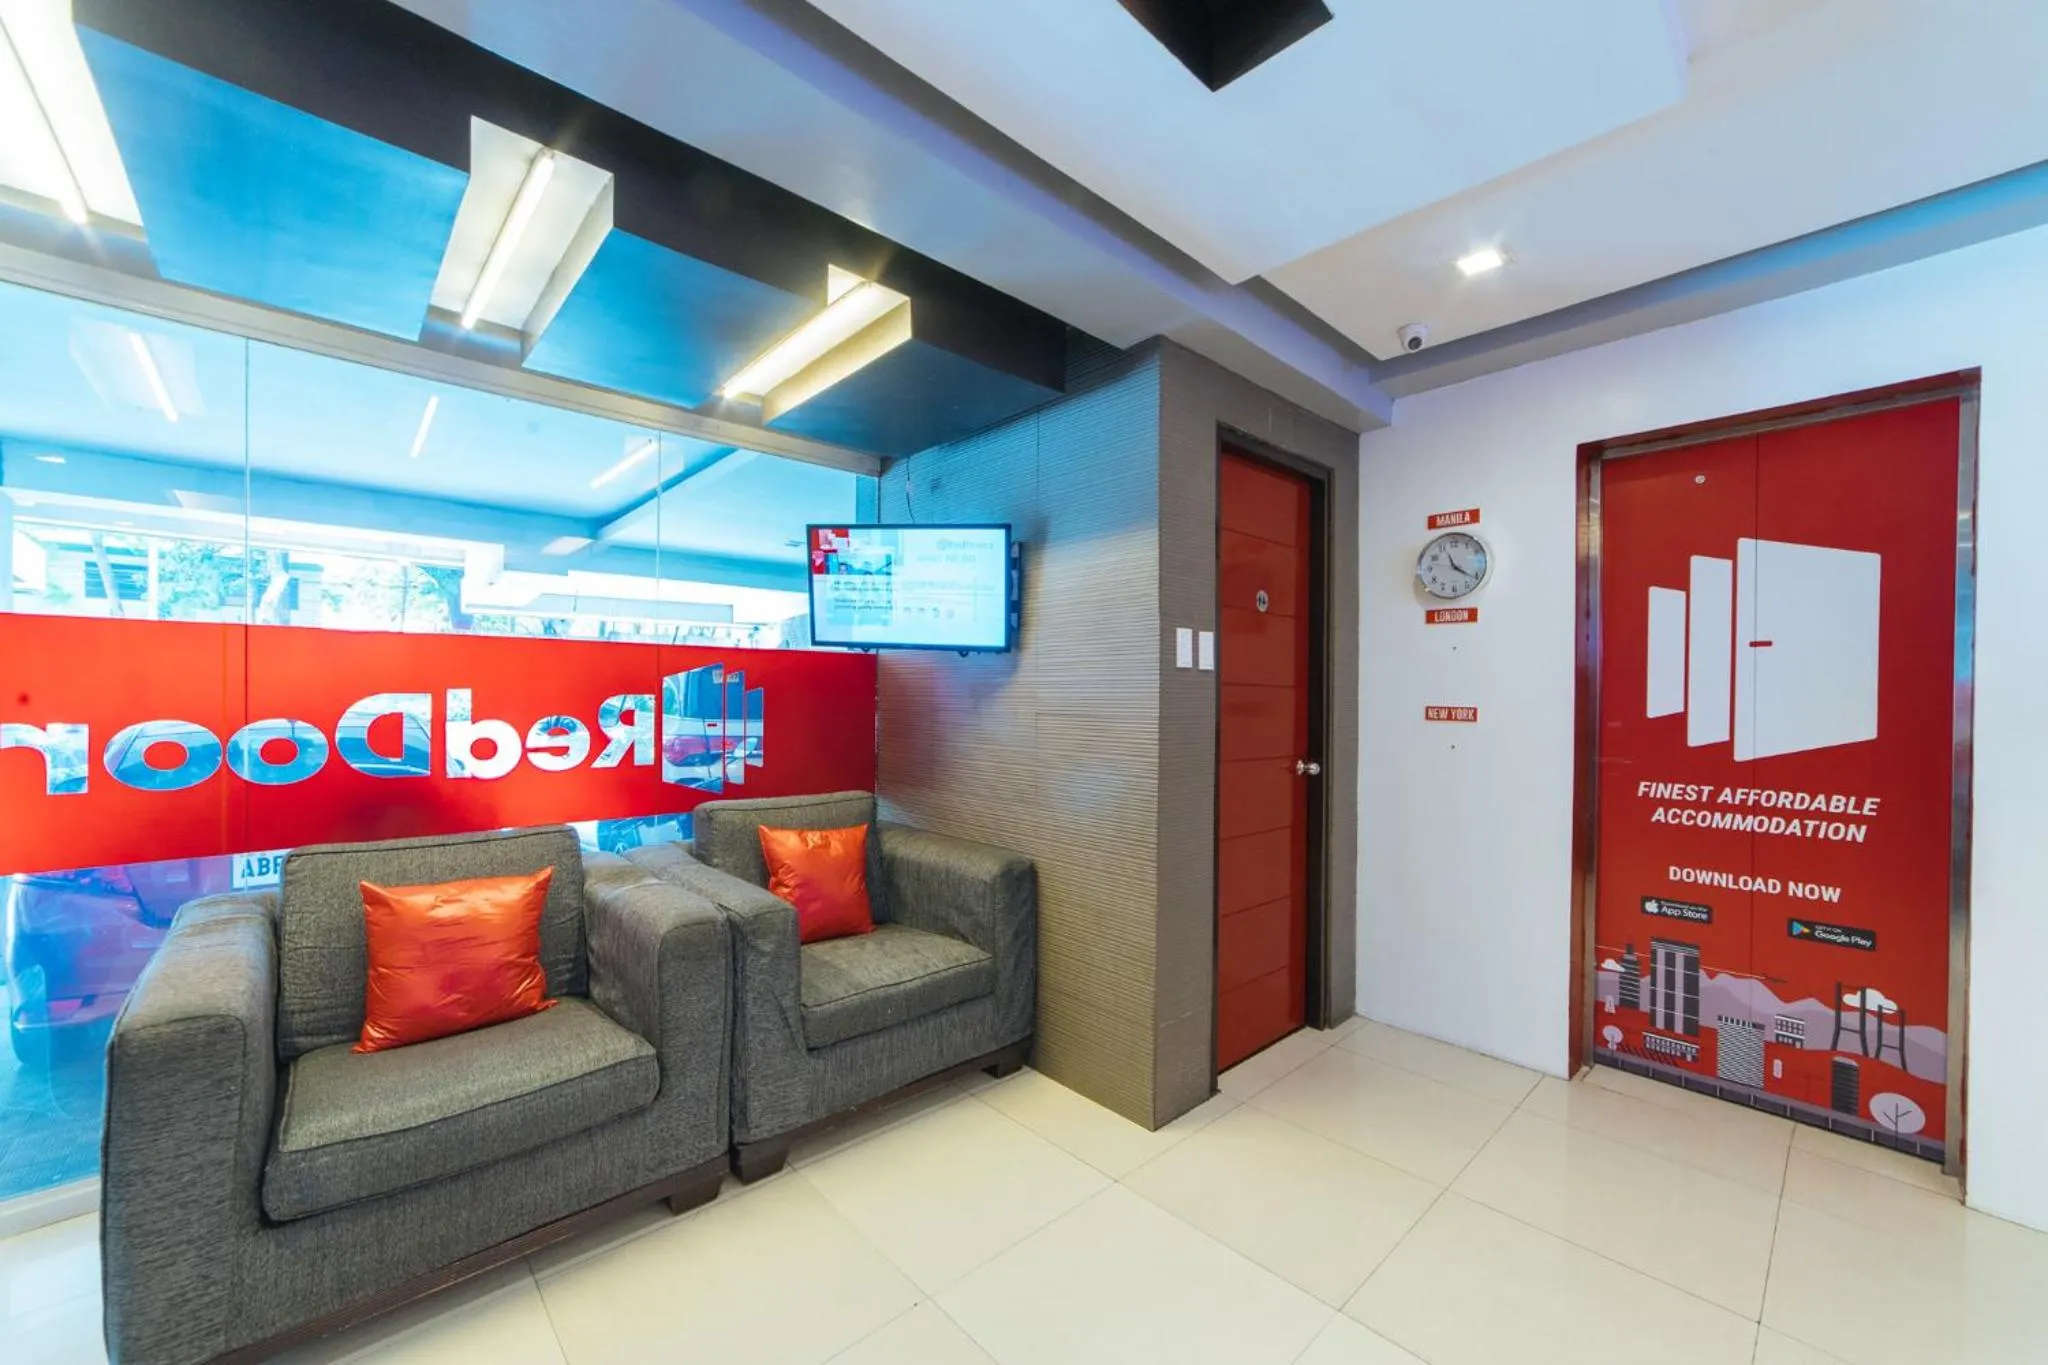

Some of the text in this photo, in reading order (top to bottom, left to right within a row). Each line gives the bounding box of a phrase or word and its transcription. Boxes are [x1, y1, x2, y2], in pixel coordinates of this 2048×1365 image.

[1436, 511, 1471, 525] MANILA
[1434, 609, 1469, 623] LONDON
[1427, 707, 1475, 721] NEW YORK
[1637, 781, 1881, 816] FINEST AFFORDABLE
[1651, 807, 1868, 843] ACCOMMODATION
[1669, 866, 1841, 903] DOWNLOAD NOW
[1660, 905, 1682, 917] App
[1682, 908, 1709, 921] Store
[1815, 930, 1872, 947] Google Play
